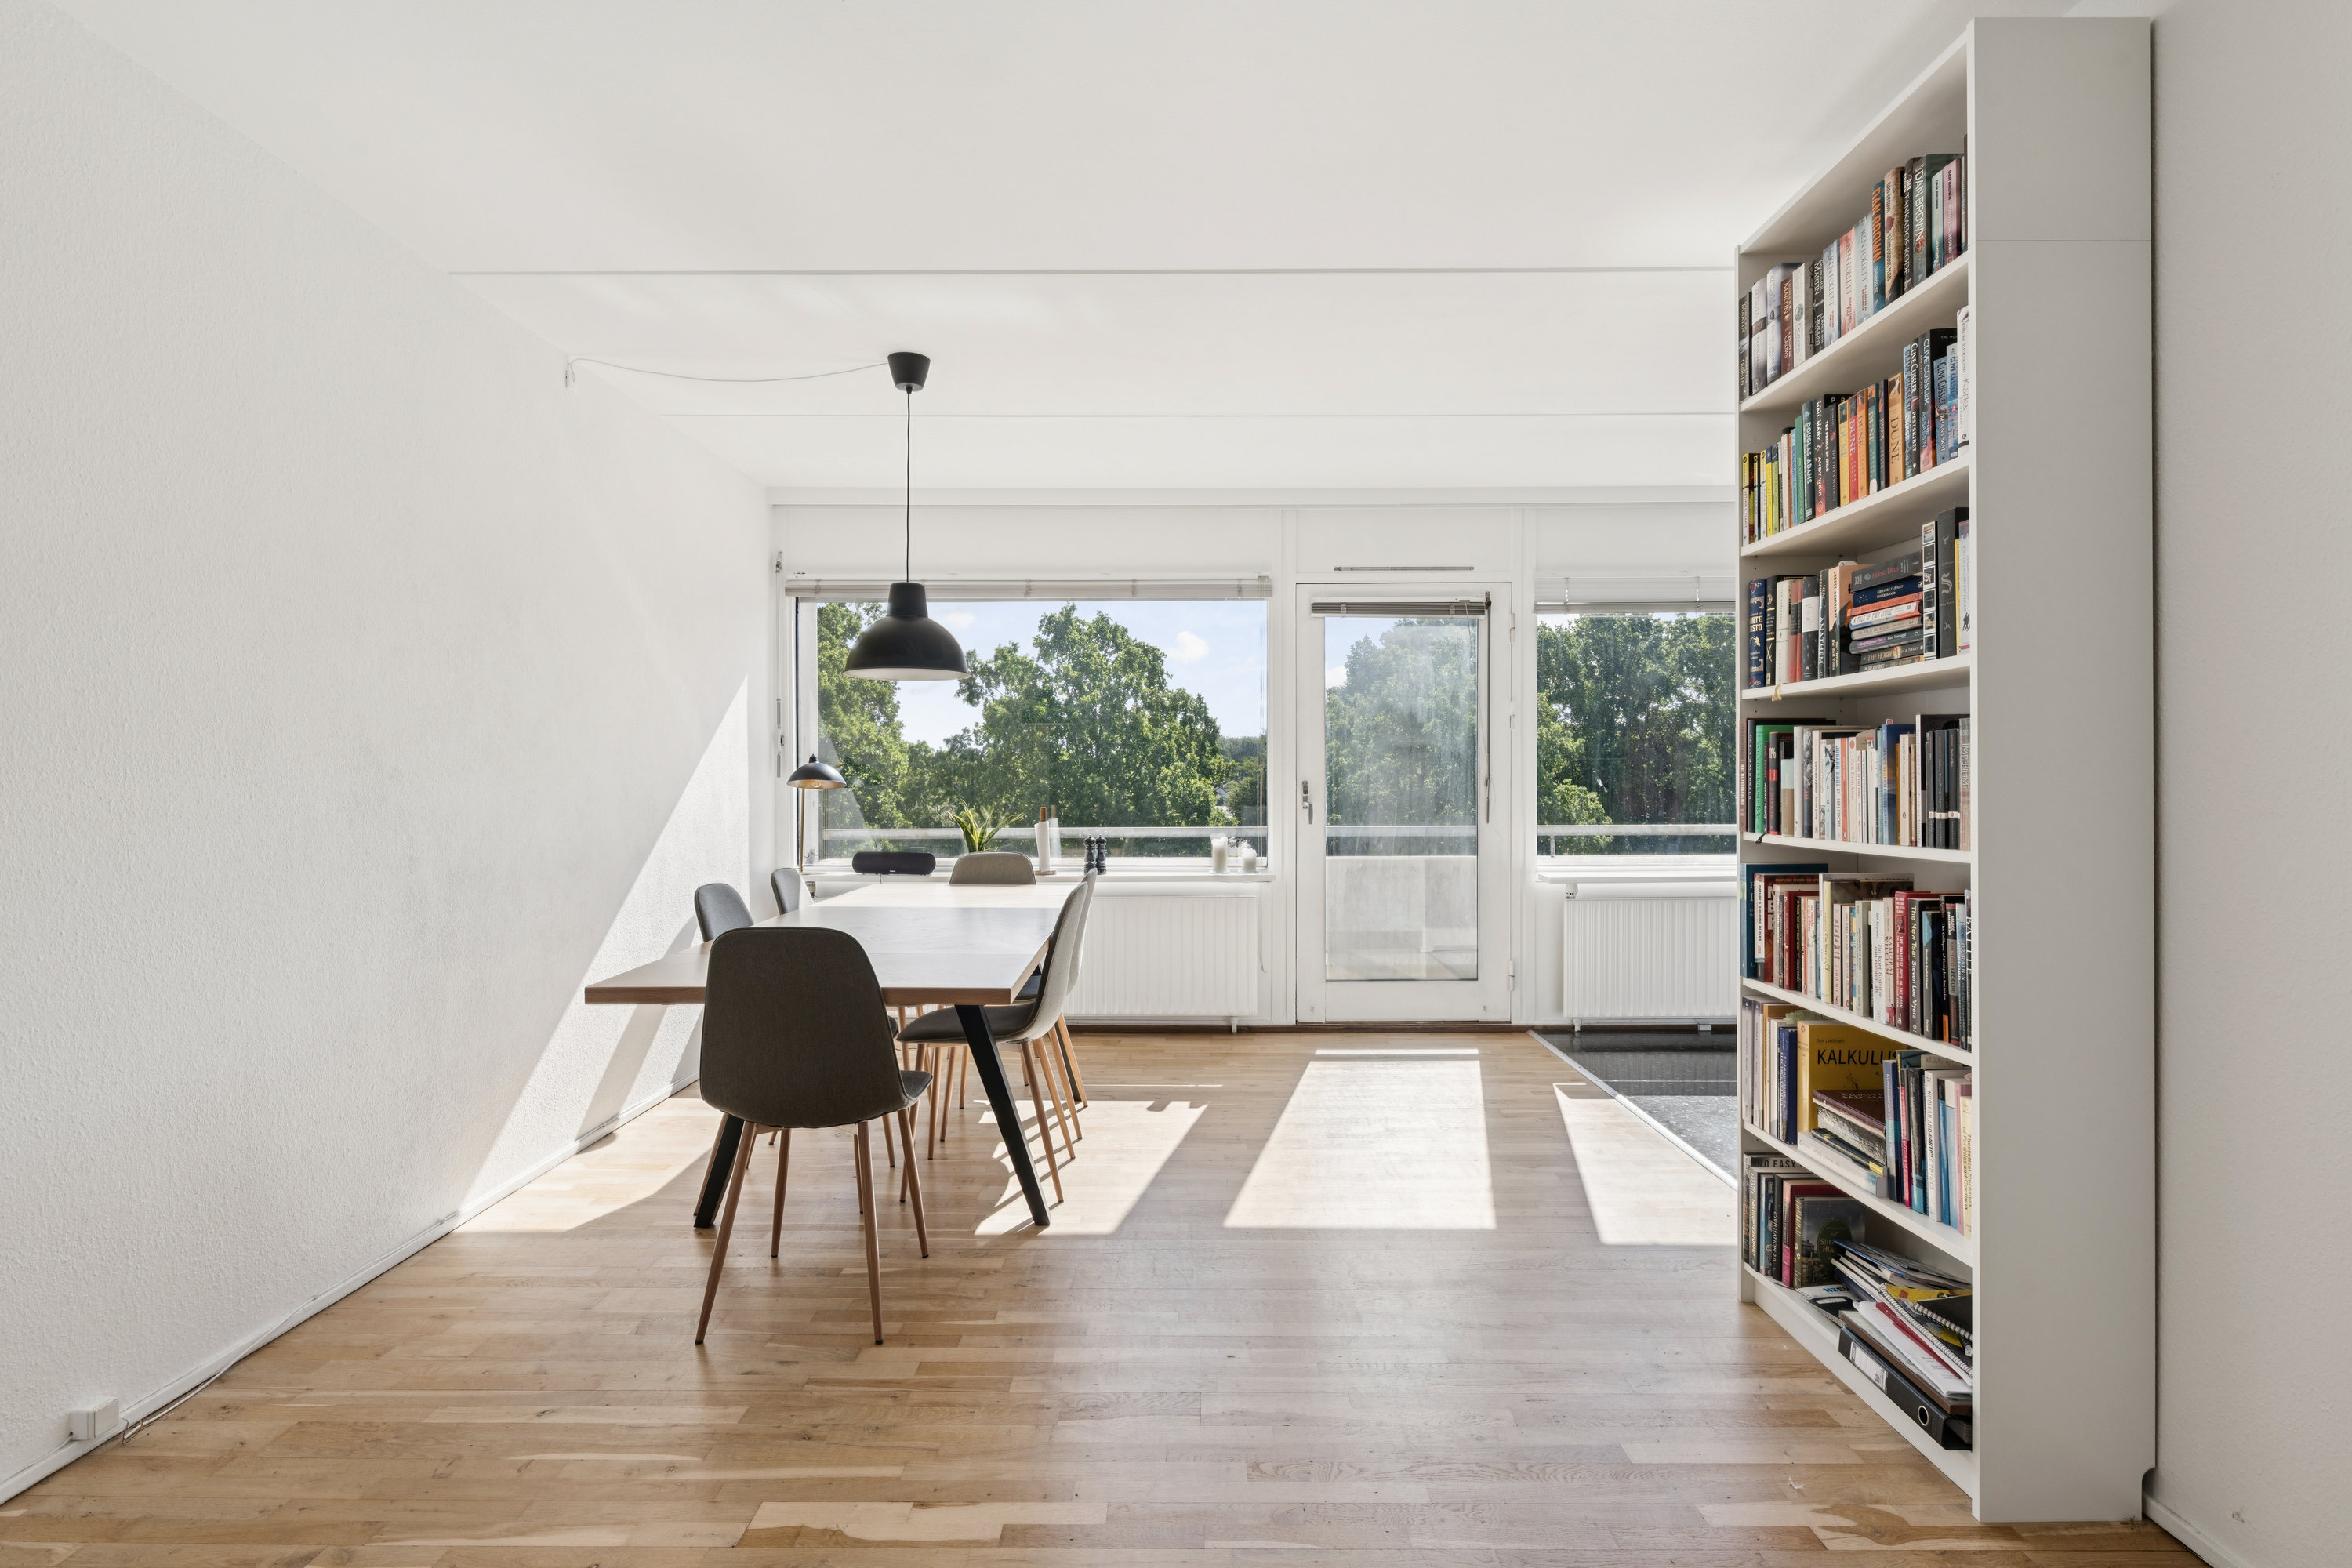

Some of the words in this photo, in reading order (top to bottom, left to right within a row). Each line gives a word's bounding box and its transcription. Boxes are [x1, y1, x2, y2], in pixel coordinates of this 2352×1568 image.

[1915, 169, 1924, 198] DAN
[1872, 187, 1882, 213] DAN
[1915, 198, 1924, 241] BROWN
[1872, 216, 1882, 263] BROWN
[1937, 362, 1946, 381] CLIVE
[1890, 416, 1899, 464] DUNE
[1961, 743, 1969, 789] IMPERIUM
[1874, 946, 1877, 956] om
[1878, 944, 1882, 953] En
